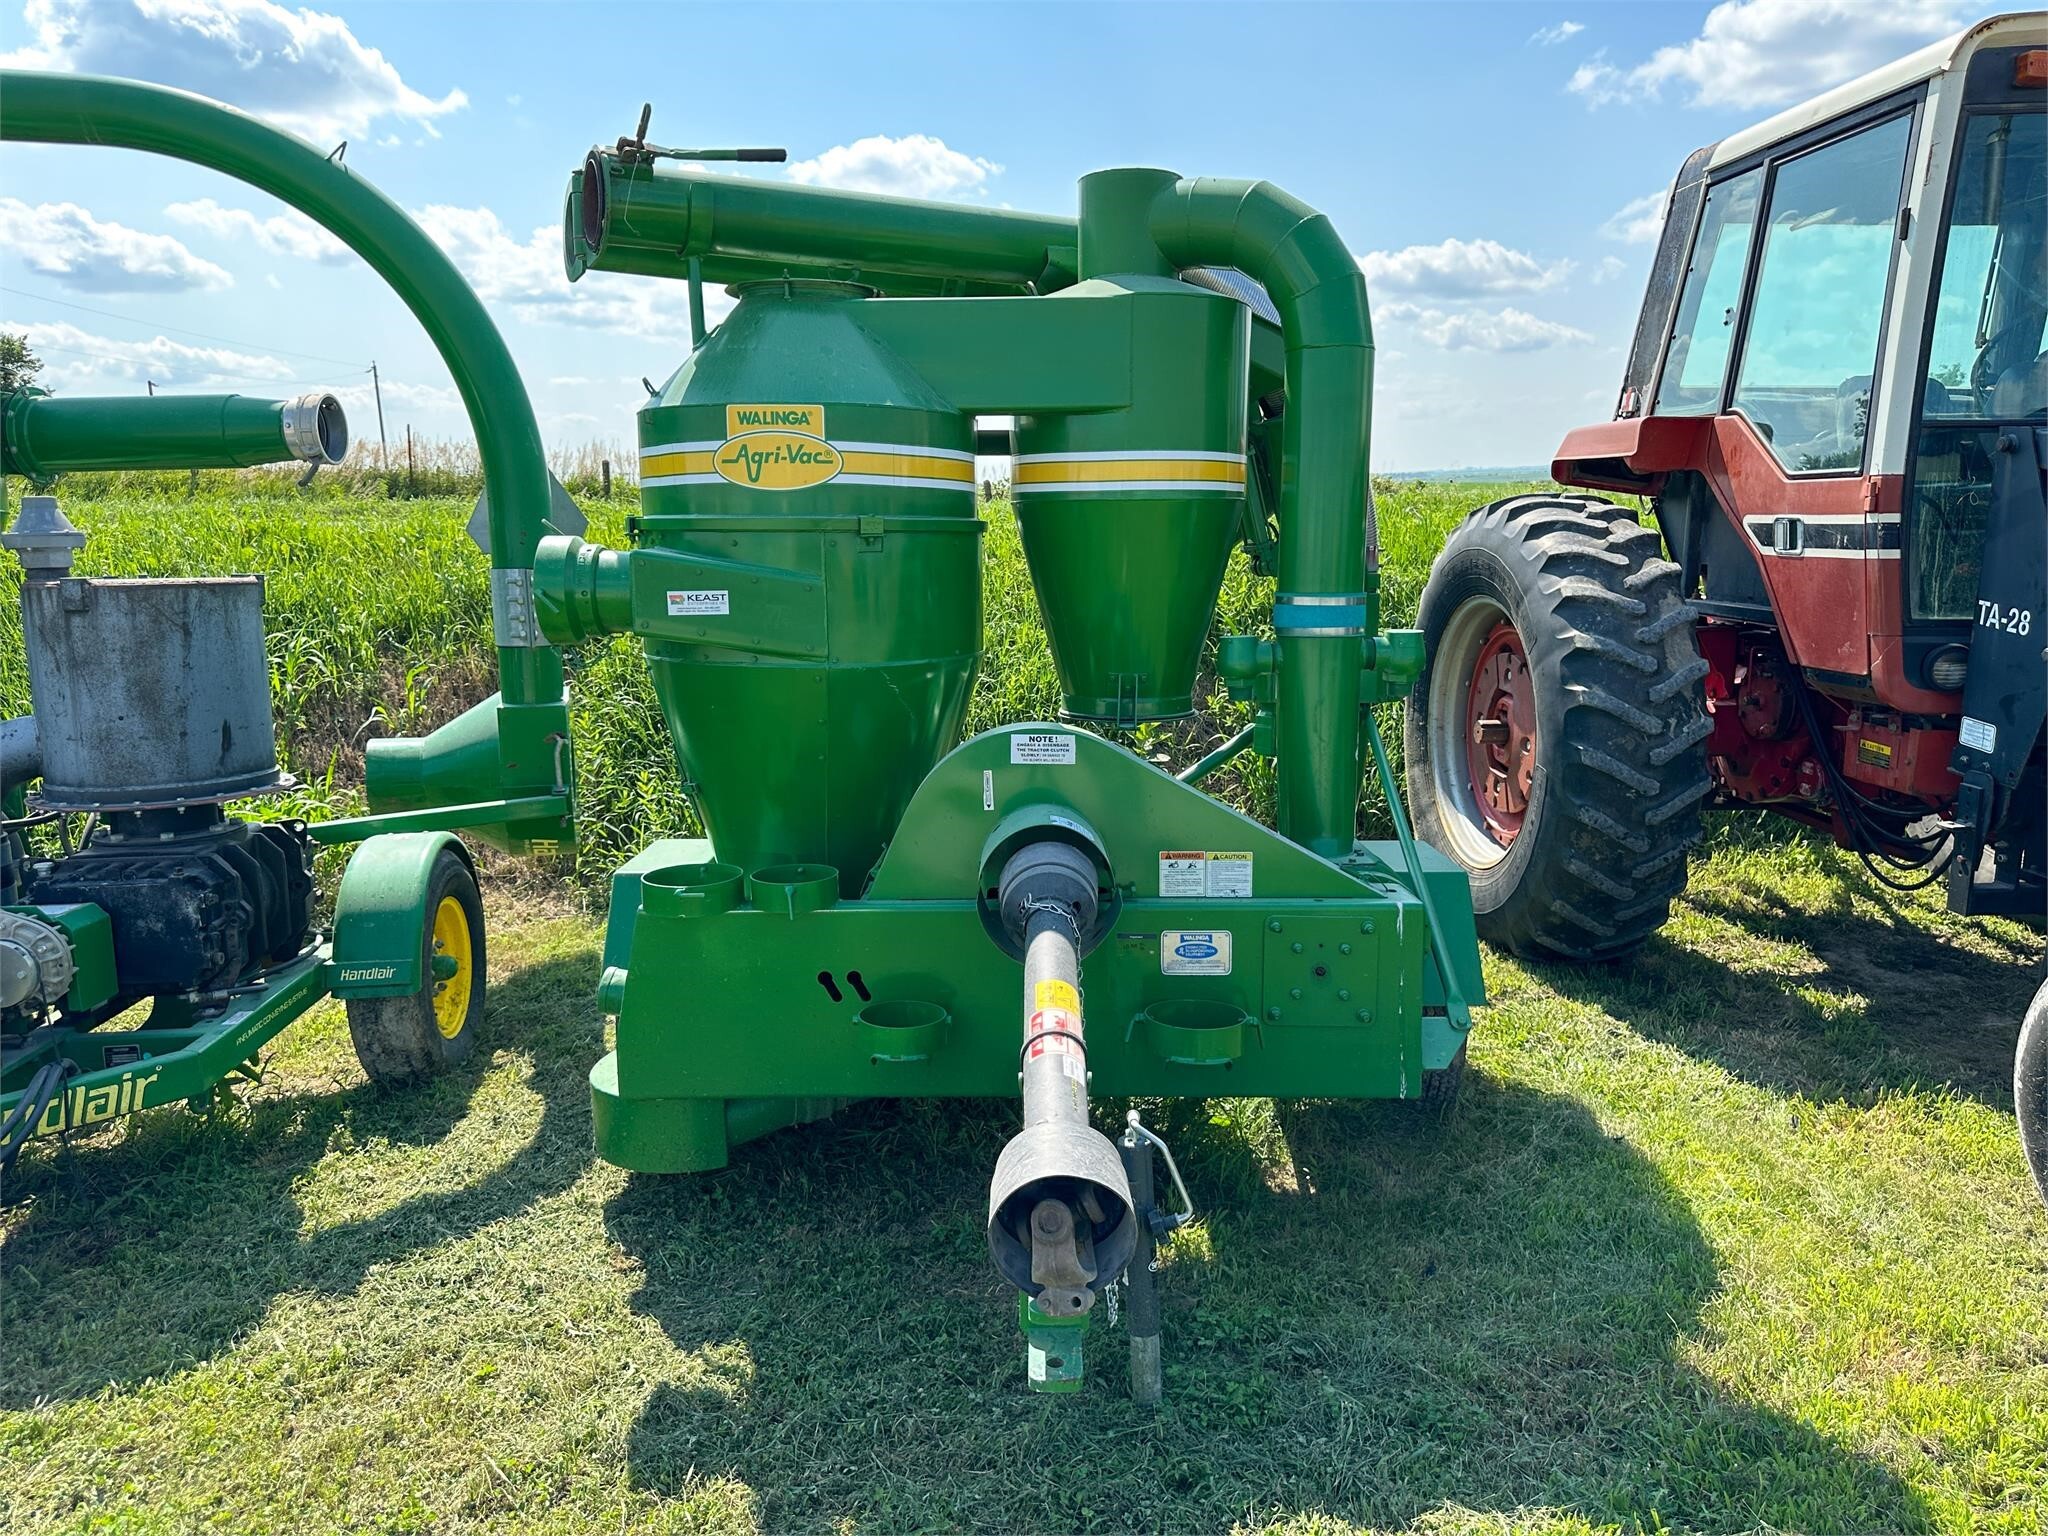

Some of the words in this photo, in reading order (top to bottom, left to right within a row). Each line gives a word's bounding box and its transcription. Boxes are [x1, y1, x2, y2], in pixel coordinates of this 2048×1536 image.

[737, 411, 811, 425] WALINGA
[722, 444, 833, 483] Agri-Vac
[1979, 600, 2031, 636] TA-28
[340, 966, 396, 981] Handlair
[236, 1020, 264, 1046] PNEUMATIC
